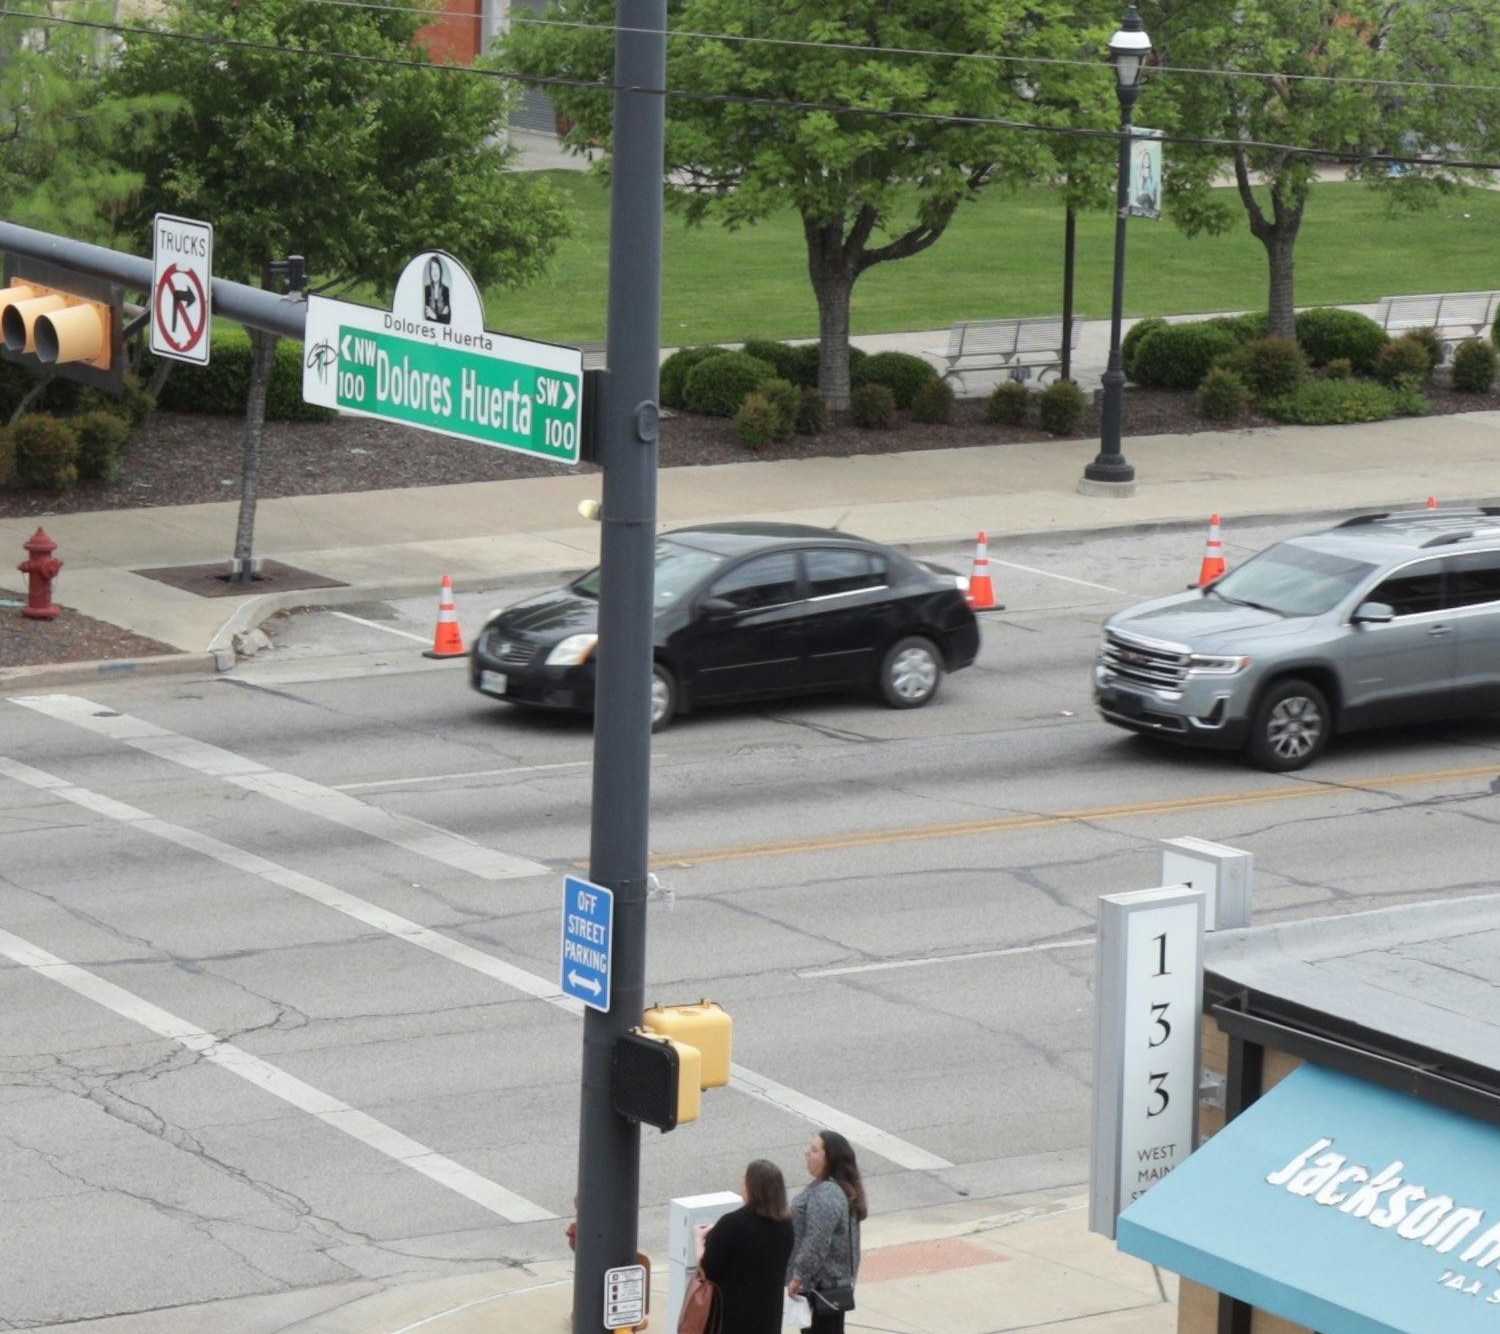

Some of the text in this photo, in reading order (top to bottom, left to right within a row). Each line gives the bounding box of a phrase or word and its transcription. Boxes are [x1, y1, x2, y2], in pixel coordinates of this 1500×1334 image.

[160, 229, 206, 257] TRUCKS
[384, 314, 493, 351] Dolores Huerta
[338, 371, 365, 402] 100
[354, 337, 560, 436] NW Dolores Huerta SW
[545, 417, 575, 451] 100
[577, 890, 598, 915] OFF
[567, 913, 606, 946] STREET
[564, 939, 607, 974] PARKING
[1136, 1143, 1177, 1162] WEST
[1264, 1136, 1486, 1254] Jackson
[1437, 1269, 1487, 1297] TAX
